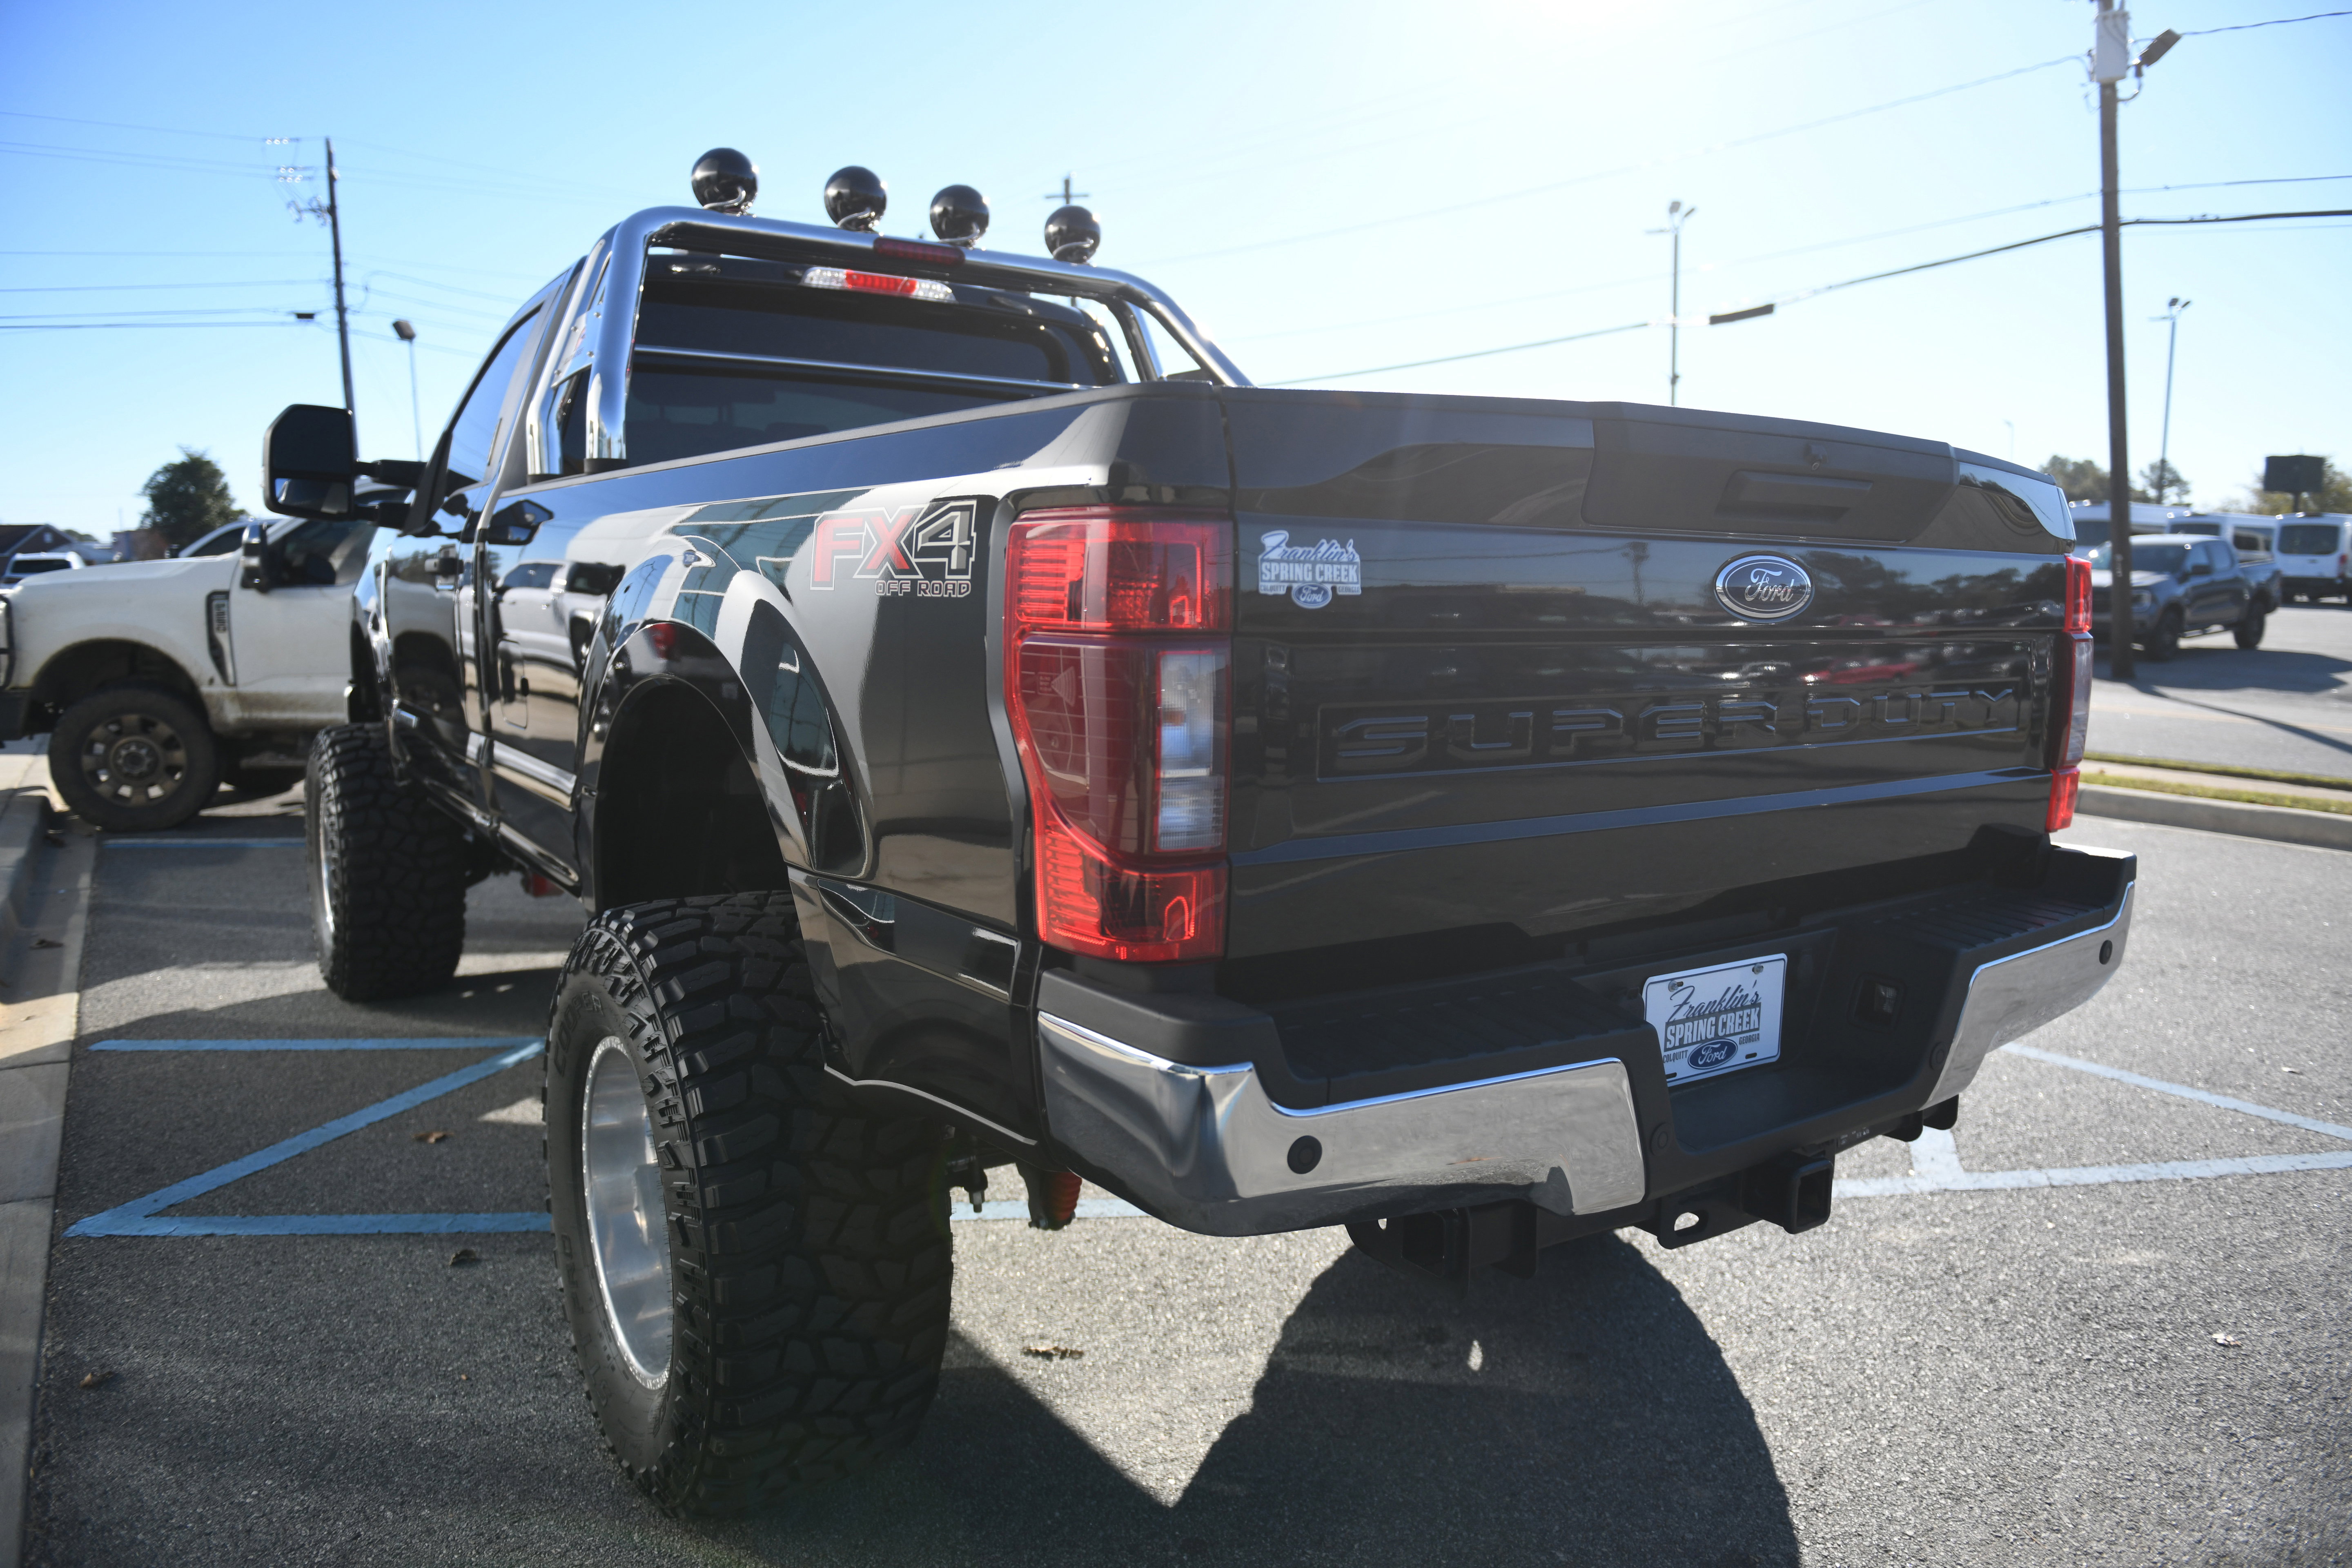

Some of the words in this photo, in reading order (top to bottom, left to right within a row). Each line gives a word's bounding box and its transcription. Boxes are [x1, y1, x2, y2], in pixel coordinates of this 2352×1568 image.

[810, 499, 977, 591] FX4
[1261, 532, 1357, 561] Franklin's
[1261, 561, 1313, 581] SPRING
[1315, 563, 1358, 583] CREEK
[1744, 568, 1795, 602] Ford
[875, 580, 911, 596] OFF
[917, 580, 971, 597] ROAD
[1299, 586, 1323, 602] Ford
[1334, 700, 1778, 771] SUPER
[1807, 688, 2013, 733] DUTY
[1668, 979, 1762, 1022] Franklin's
[553, 990, 605, 1077] COOPER
[1666, 1016, 1716, 1049] SPRING
[1718, 1007, 1760, 1037] CREEK
[1739, 1033, 1760, 1045] GEORGIA
[1663, 1049, 1688, 1063] COLQUITT
[1698, 1044, 1728, 1065] Ford
